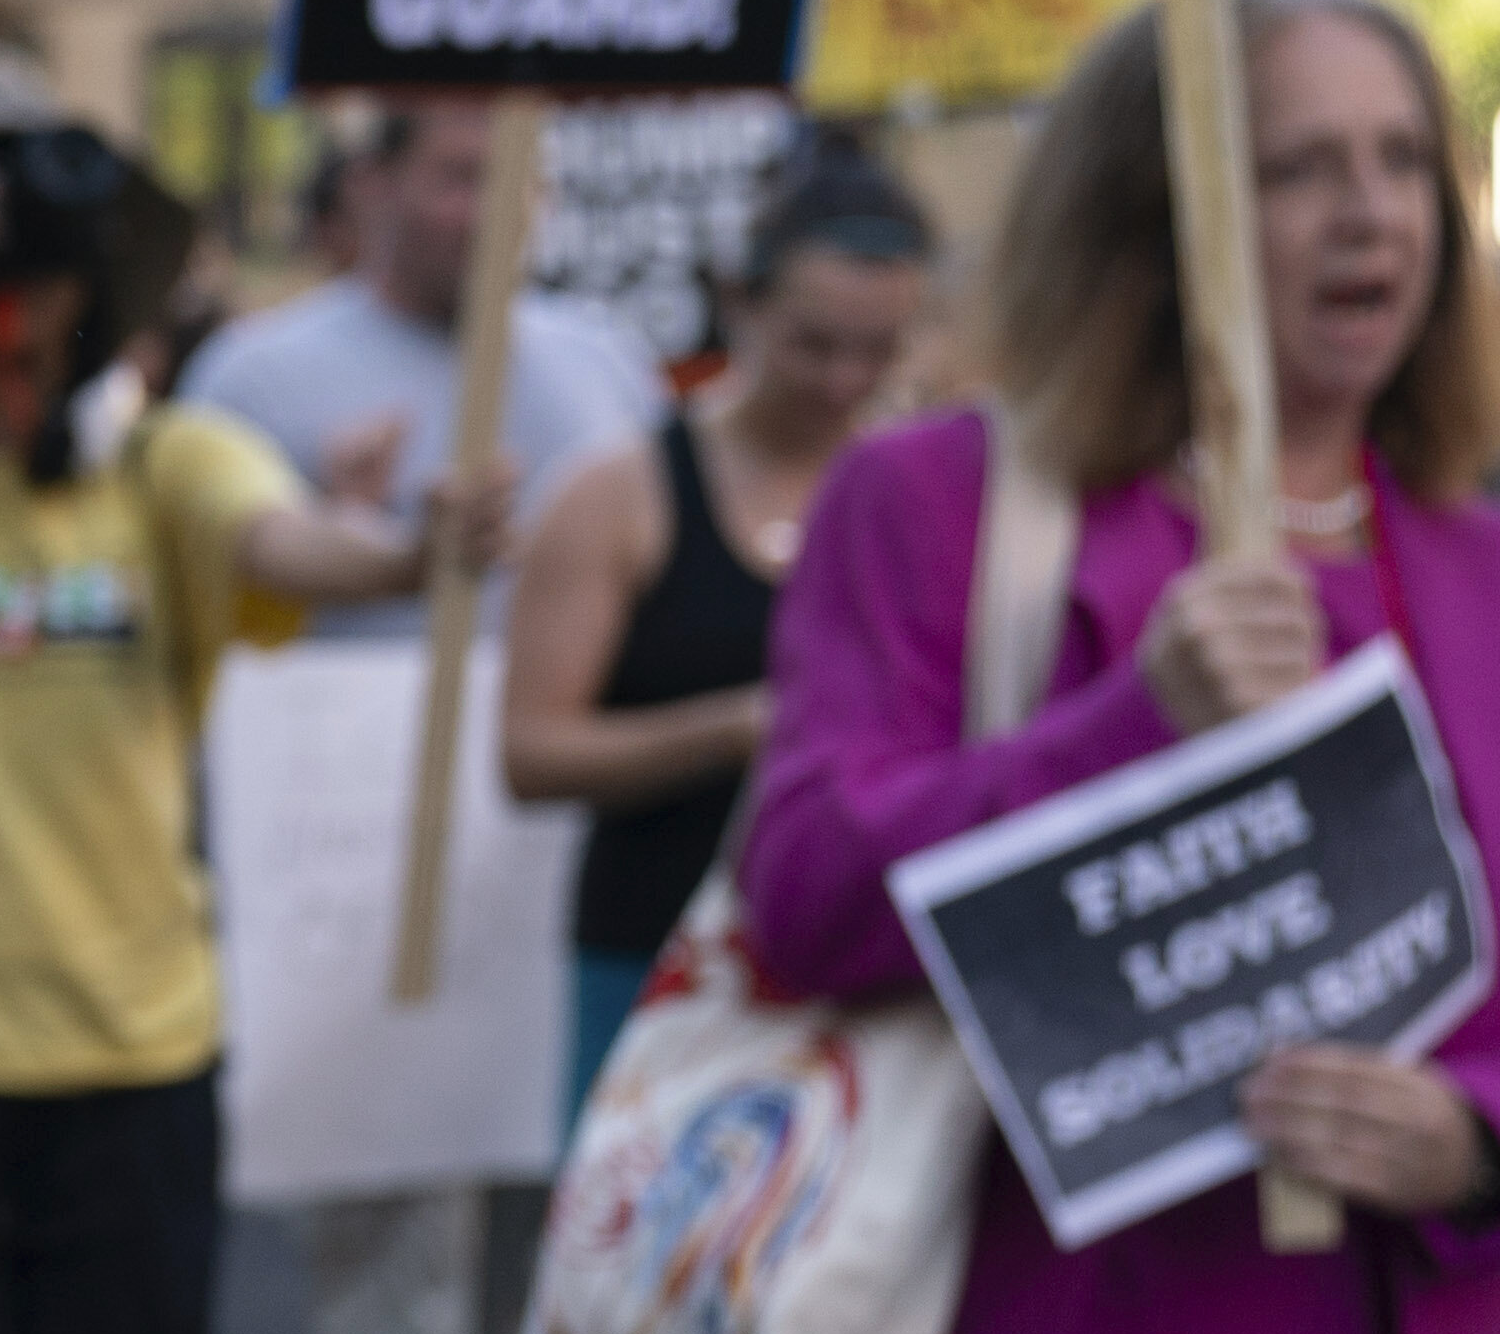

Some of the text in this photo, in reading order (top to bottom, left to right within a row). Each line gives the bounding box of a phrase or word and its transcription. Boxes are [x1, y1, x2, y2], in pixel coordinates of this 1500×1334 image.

[1063, 777, 1313, 936] FAITH
[1039, 891, 1452, 1146] SOLIDARITY
[1119, 873, 1331, 1011] LOVE
